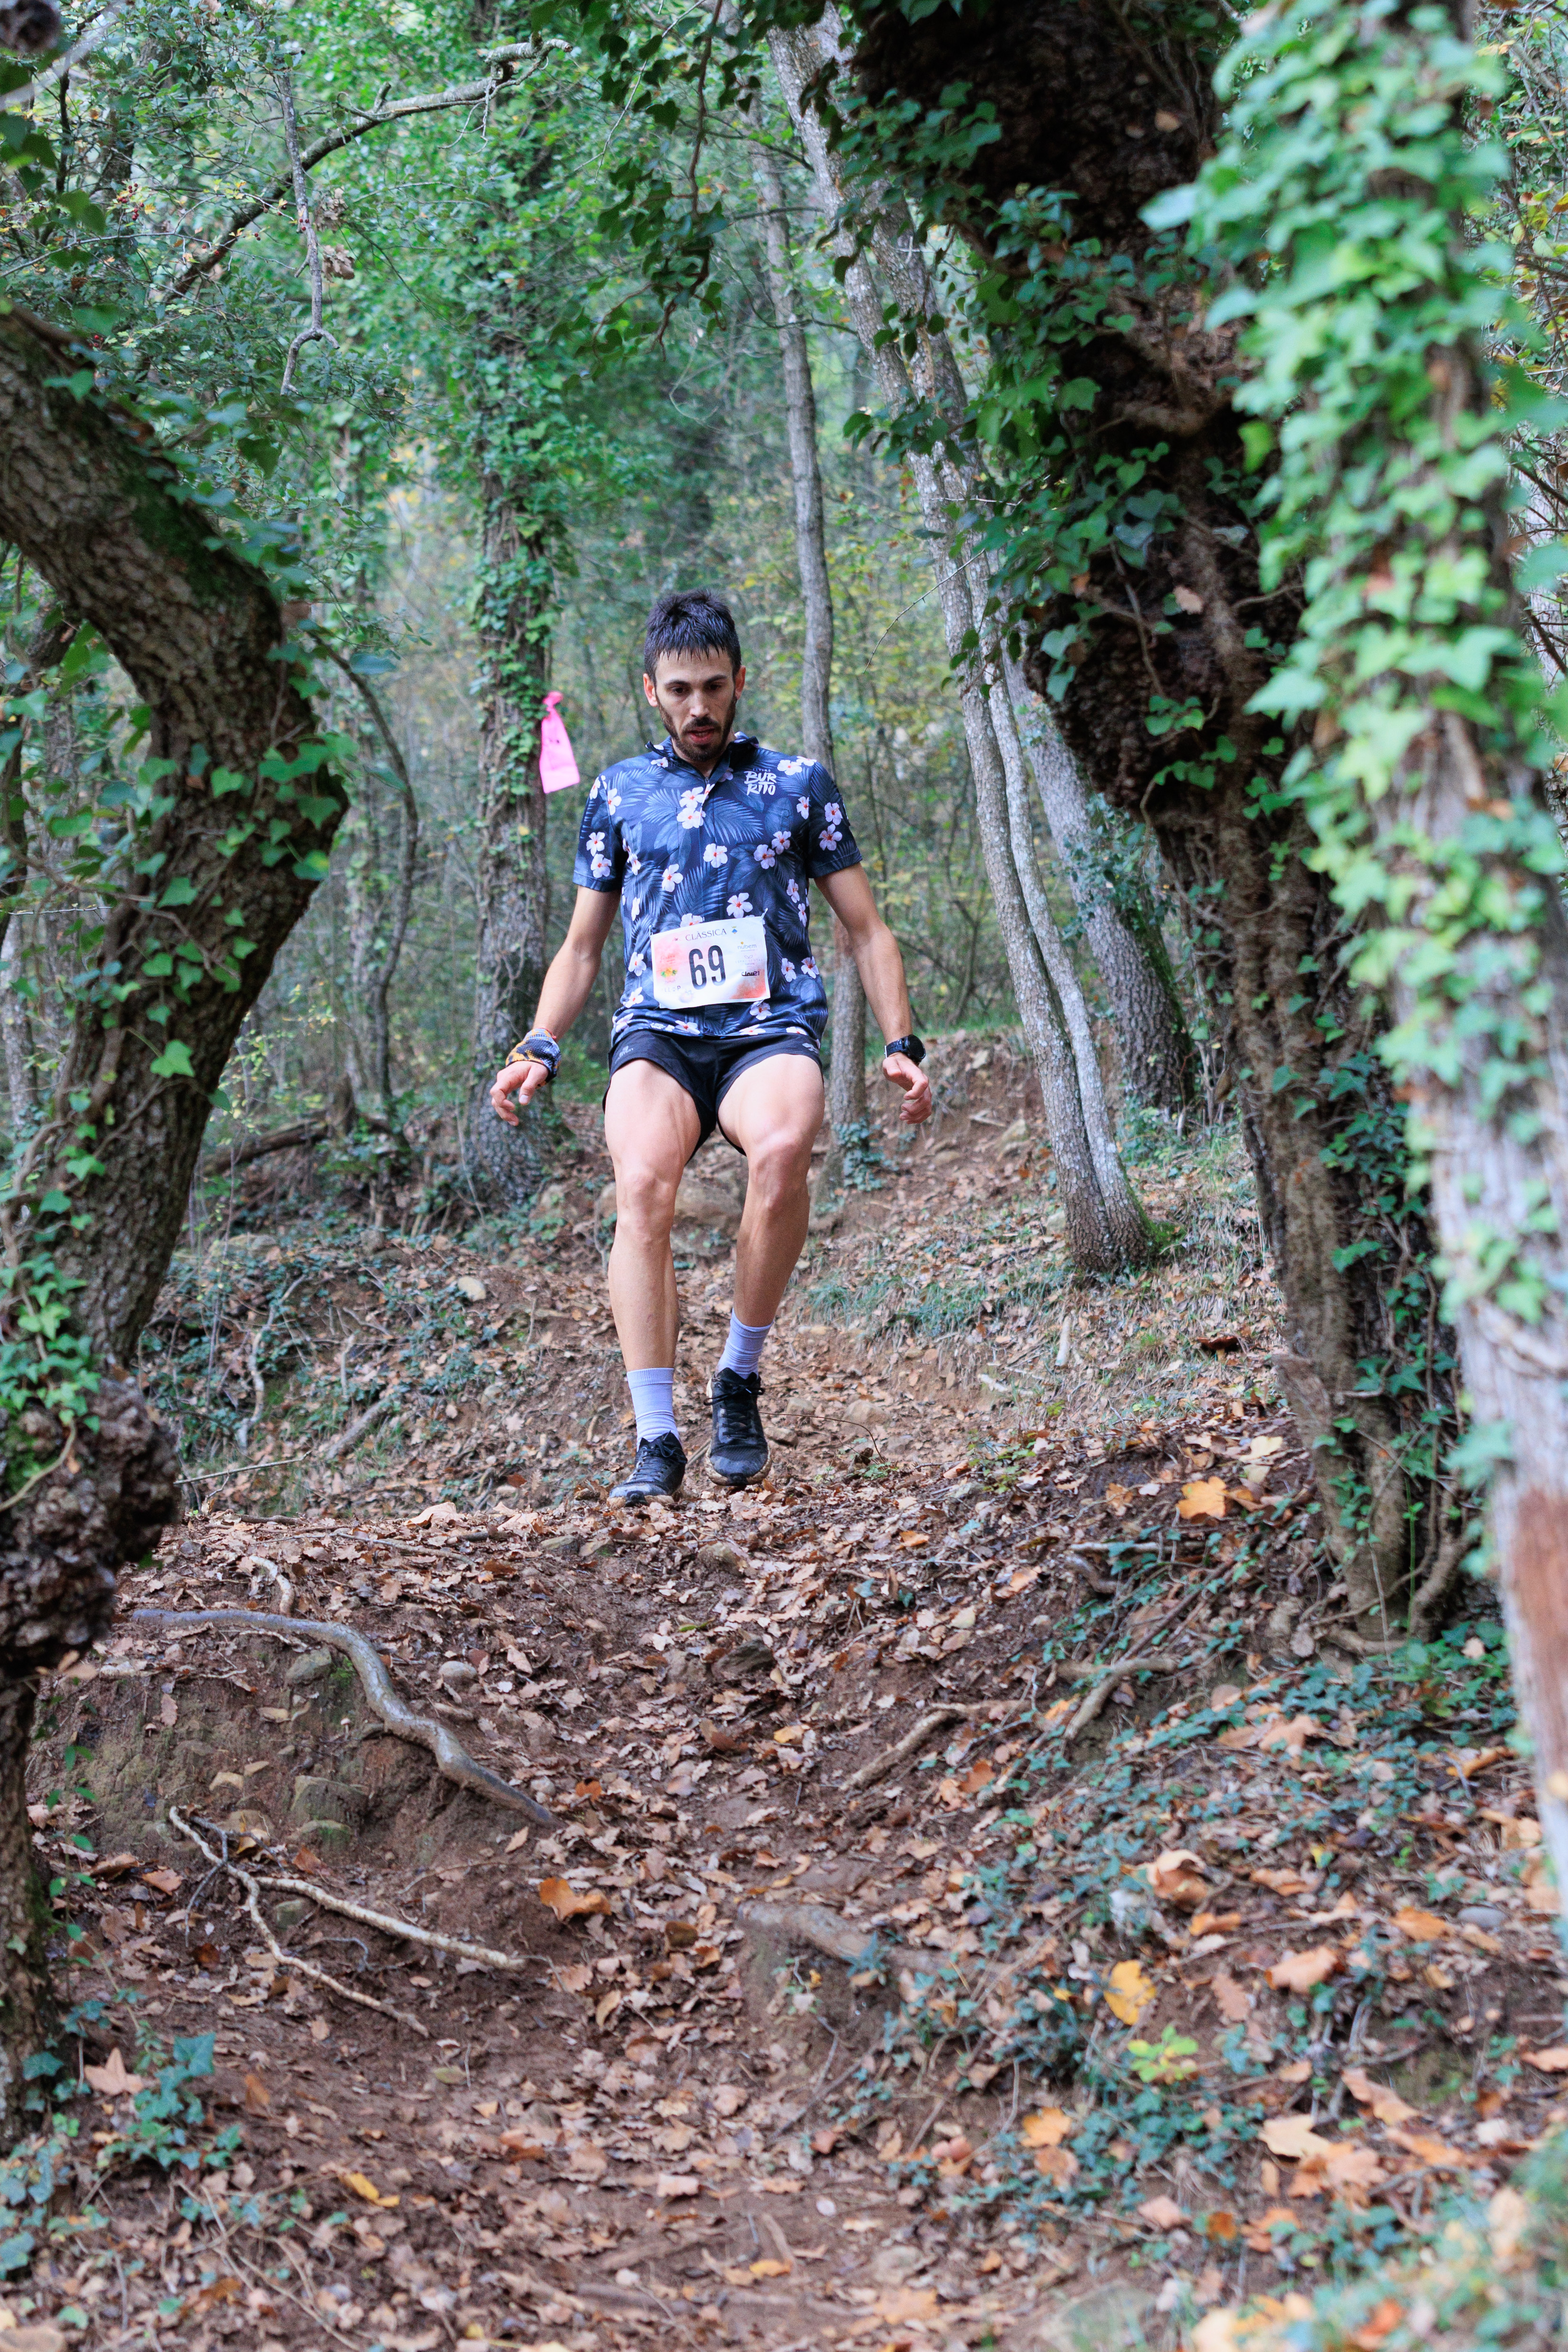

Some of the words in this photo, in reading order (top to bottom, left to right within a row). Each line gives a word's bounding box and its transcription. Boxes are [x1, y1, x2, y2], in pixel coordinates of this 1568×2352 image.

[744, 771, 776, 784] BUR
[746, 781, 776, 795] RITO
[685, 928, 727, 941] CLÀSSICA
[688, 945, 726, 990] 69
